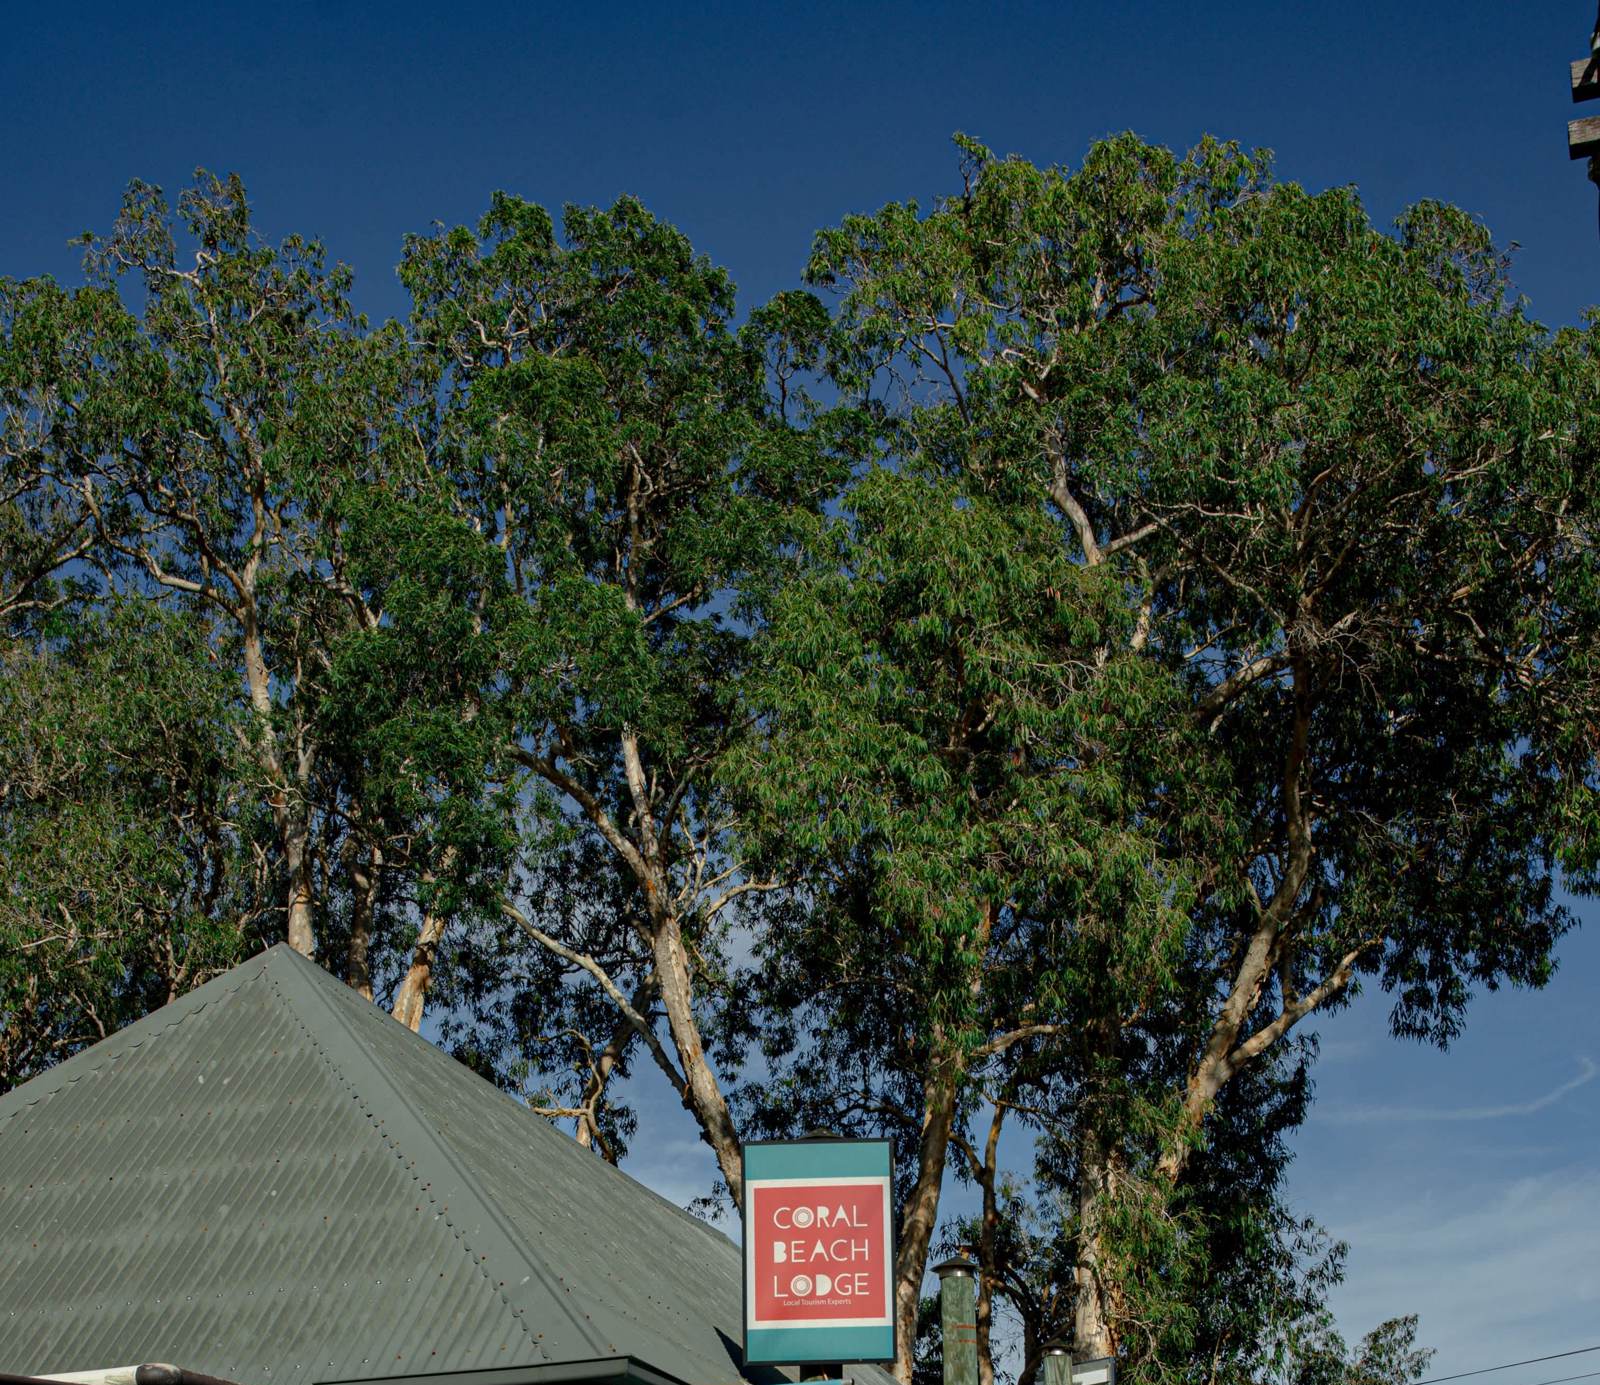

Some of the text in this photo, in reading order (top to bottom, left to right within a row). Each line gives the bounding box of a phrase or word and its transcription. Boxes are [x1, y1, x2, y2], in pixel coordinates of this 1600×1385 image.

[773, 1205, 868, 1229] CORAL
[773, 1239, 869, 1263] BEACH
[773, 1273, 869, 1298] LODGE
[801, 1298, 826, 1306] Tourism
[827, 1298, 852, 1307] Experts
